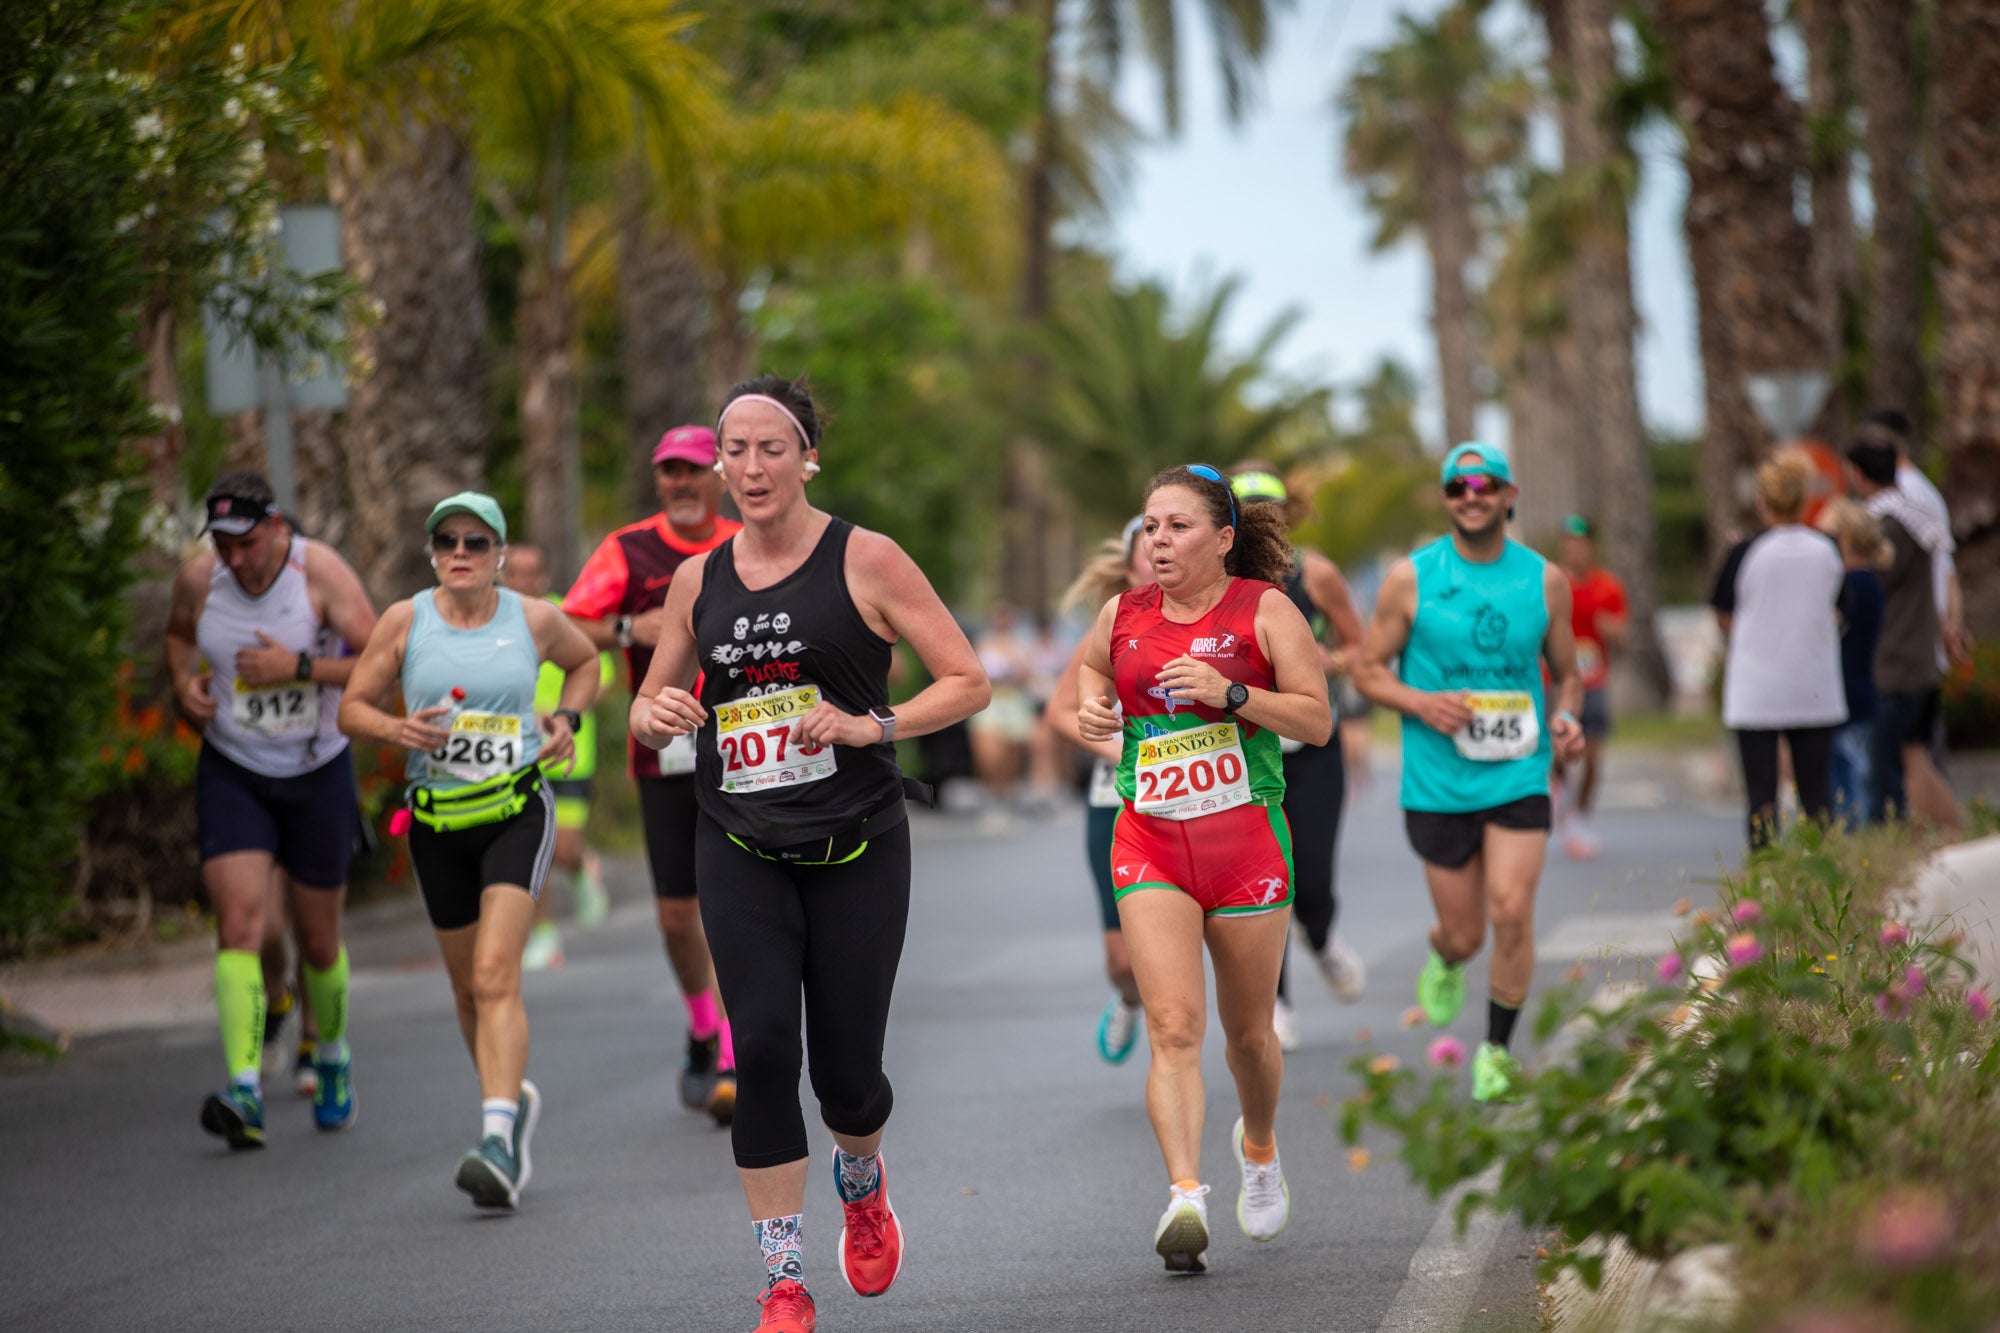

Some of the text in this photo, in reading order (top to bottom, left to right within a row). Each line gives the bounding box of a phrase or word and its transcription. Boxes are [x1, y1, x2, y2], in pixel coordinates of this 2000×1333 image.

[1190, 638, 1217, 652] ATARFE
[247, 690, 304, 721] 912
[730, 707, 739, 723] 38
[738, 701, 794, 722] FONDO
[740, 702, 761, 710] GRAN
[763, 696, 786, 706] PREMIO
[1159, 738, 1179, 747] GRAN
[1181, 731, 1208, 742] PREMIO
[1469, 716, 1521, 741] 645
[1157, 736, 1215, 758] FONDO
[1139, 753, 1242, 803] 2200
